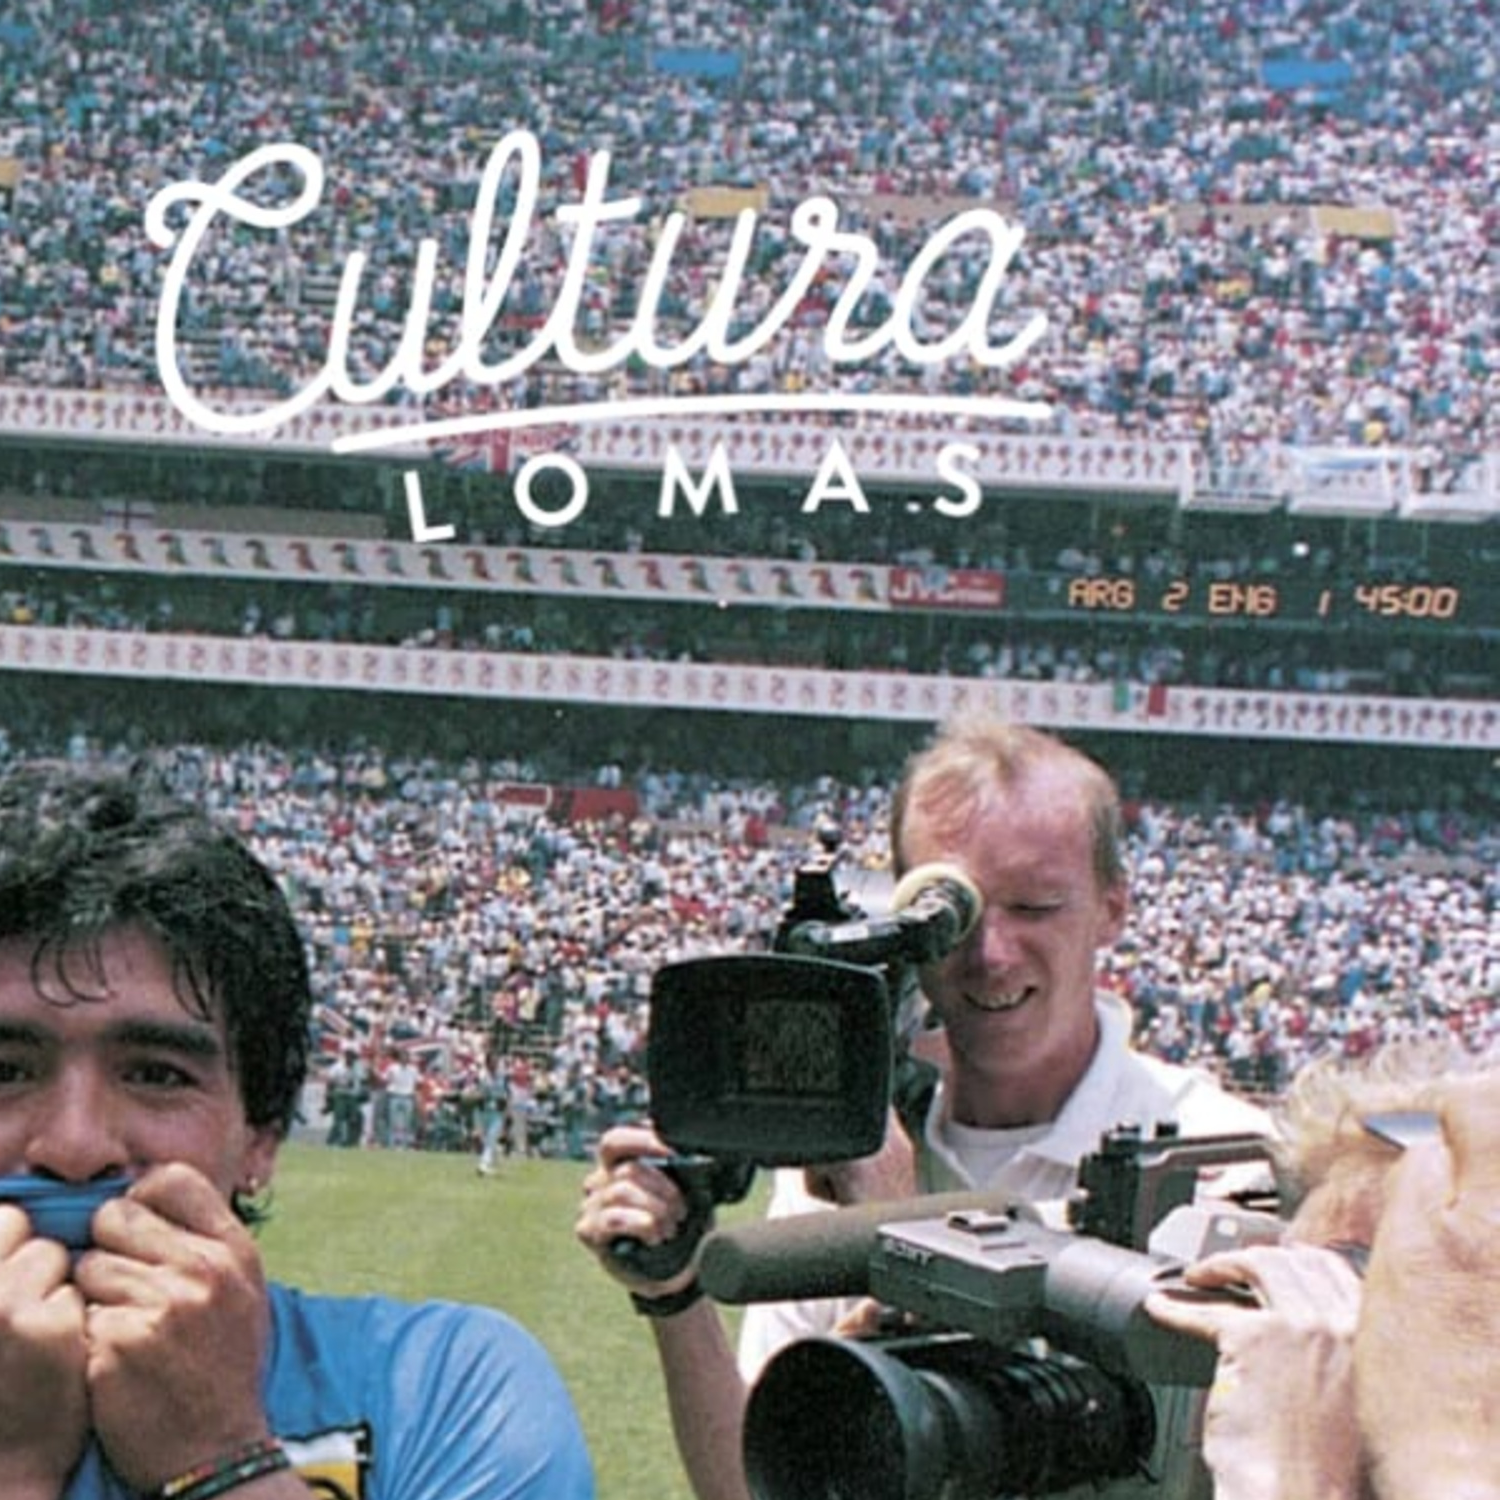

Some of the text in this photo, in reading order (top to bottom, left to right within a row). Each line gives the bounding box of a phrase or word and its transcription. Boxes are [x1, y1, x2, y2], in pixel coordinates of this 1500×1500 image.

[1068, 579, 1459, 617] ARG 2 ENG 1 45:00
